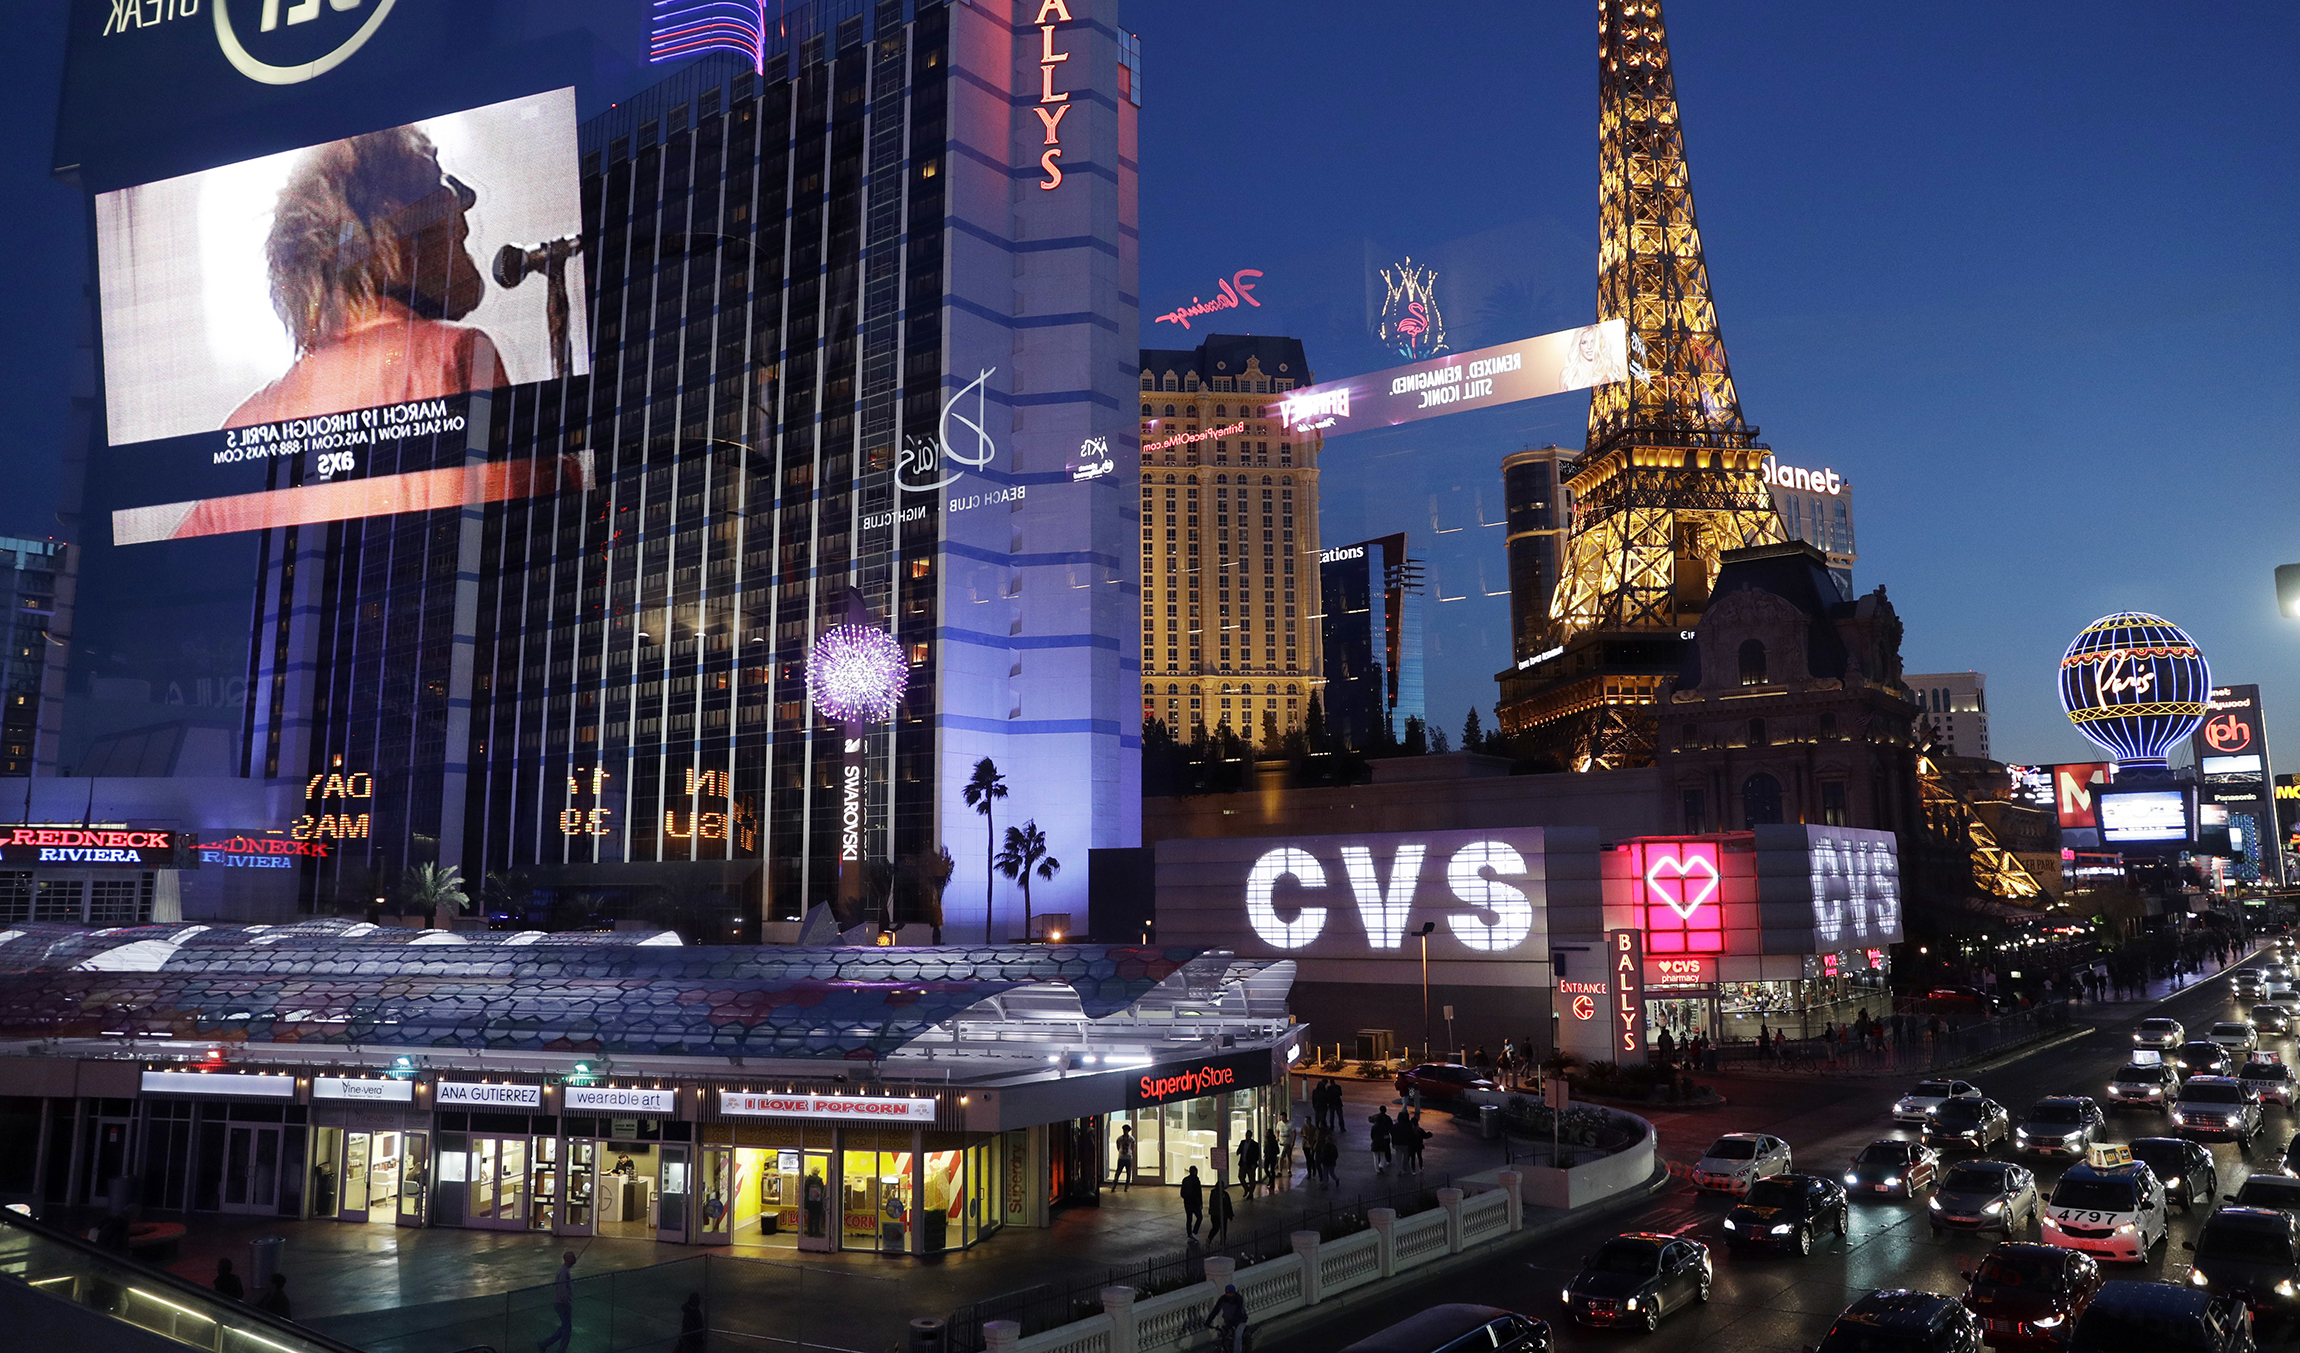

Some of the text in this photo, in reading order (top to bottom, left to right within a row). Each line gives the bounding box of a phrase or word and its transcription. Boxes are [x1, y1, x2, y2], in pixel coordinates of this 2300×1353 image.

[1033, 0, 1073, 190] ALLYS
[2095, 648, 2156, 712] Paris
[2214, 793, 2257, 802] Panasonic
[843, 765, 858, 861] SWAROVSKI
[11, 829, 169, 849] REDNECK
[39, 848, 141, 863] RIVIERA
[2037, 859, 2056, 872] PARK
[1246, 841, 1532, 951] CVS
[1811, 836, 1897, 942] CVS
[1672, 960, 1700, 973] CVS
[1661, 973, 1700, 983] pharmacy
[1618, 934, 1636, 1051] BALLYS
[440, 1086, 537, 1103] ANA GUTIERREZ
[576, 1092, 661, 1107] wearable art
[745, 1098, 909, 1115] I LOVE POPCORN
[844, 1213, 876, 1230] CORN
[2058, 1209, 2117, 1225] 4797
